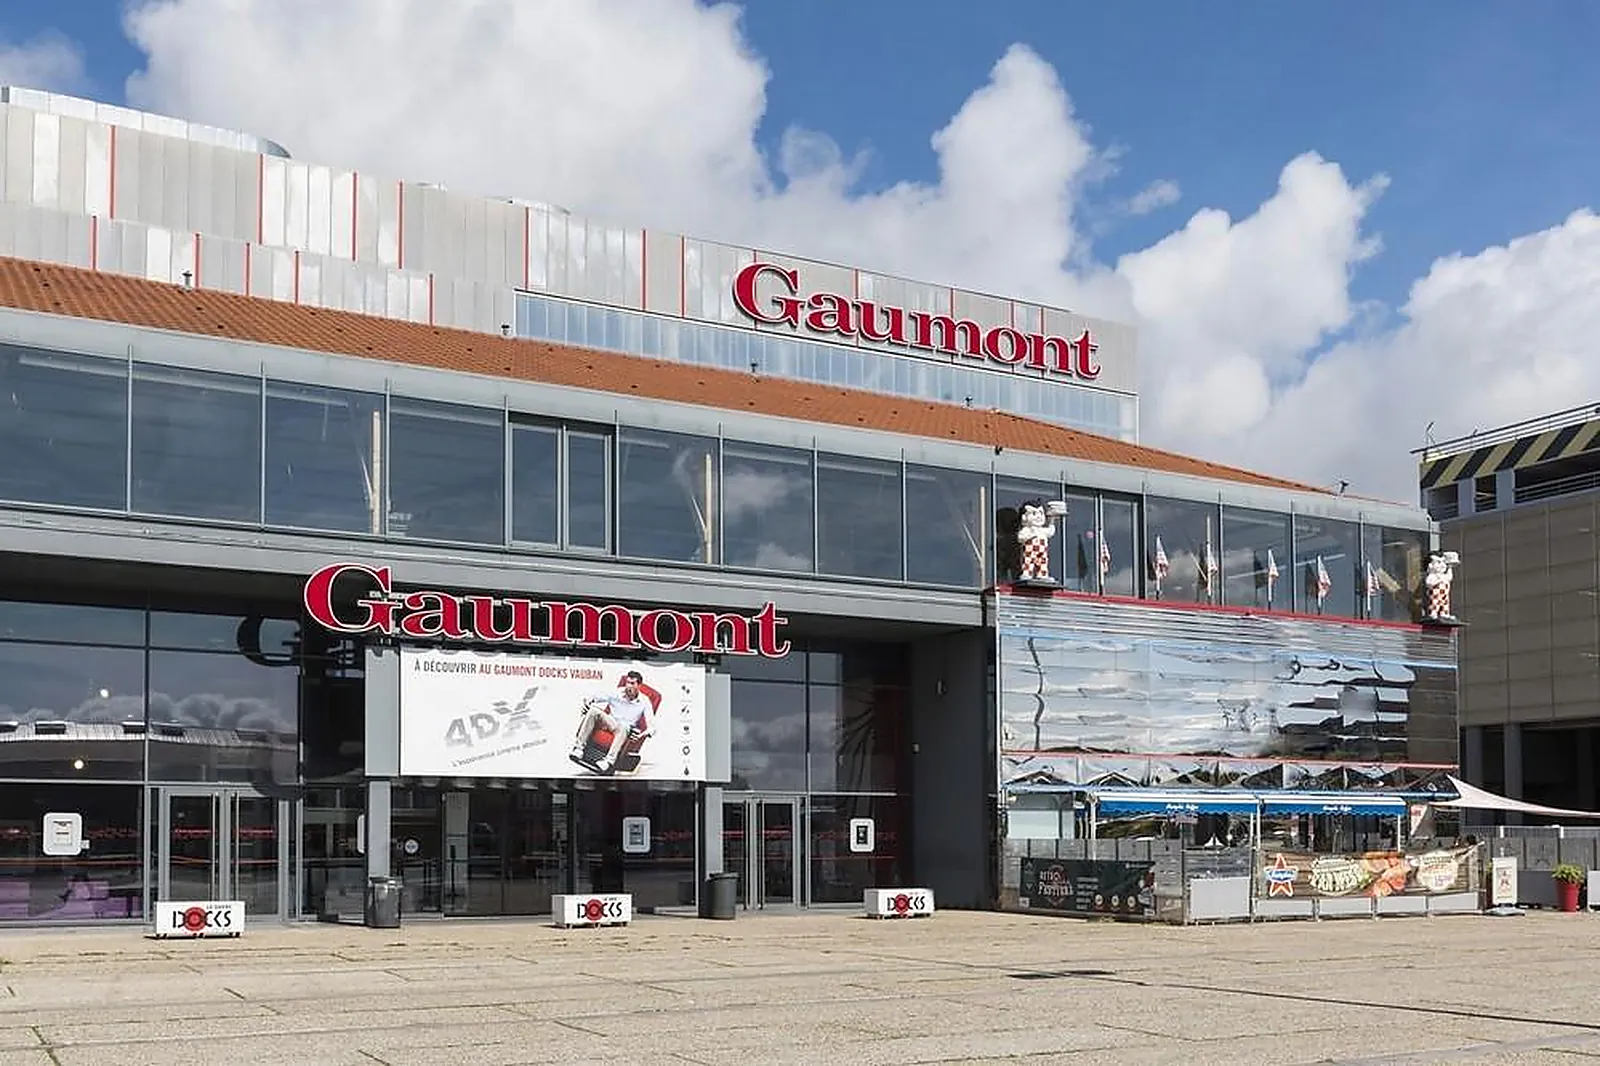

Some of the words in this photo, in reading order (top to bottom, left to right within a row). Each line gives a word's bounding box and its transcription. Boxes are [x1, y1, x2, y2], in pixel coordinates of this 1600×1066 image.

[733, 261, 1101, 379] Gaumont
[304, 562, 790, 657] Gaumont
[423, 660, 477, 674] DÉCOUVRIR
[478, 663, 492, 675] AU
[493, 664, 537, 678] GAUMONT
[538, 666, 568, 679] DOCKS
[569, 668, 603, 681] VAUBAN
[577, 898, 623, 921] DOCKS
[887, 894, 926, 914] DOCKS
[172, 906, 232, 932] DOCKS
